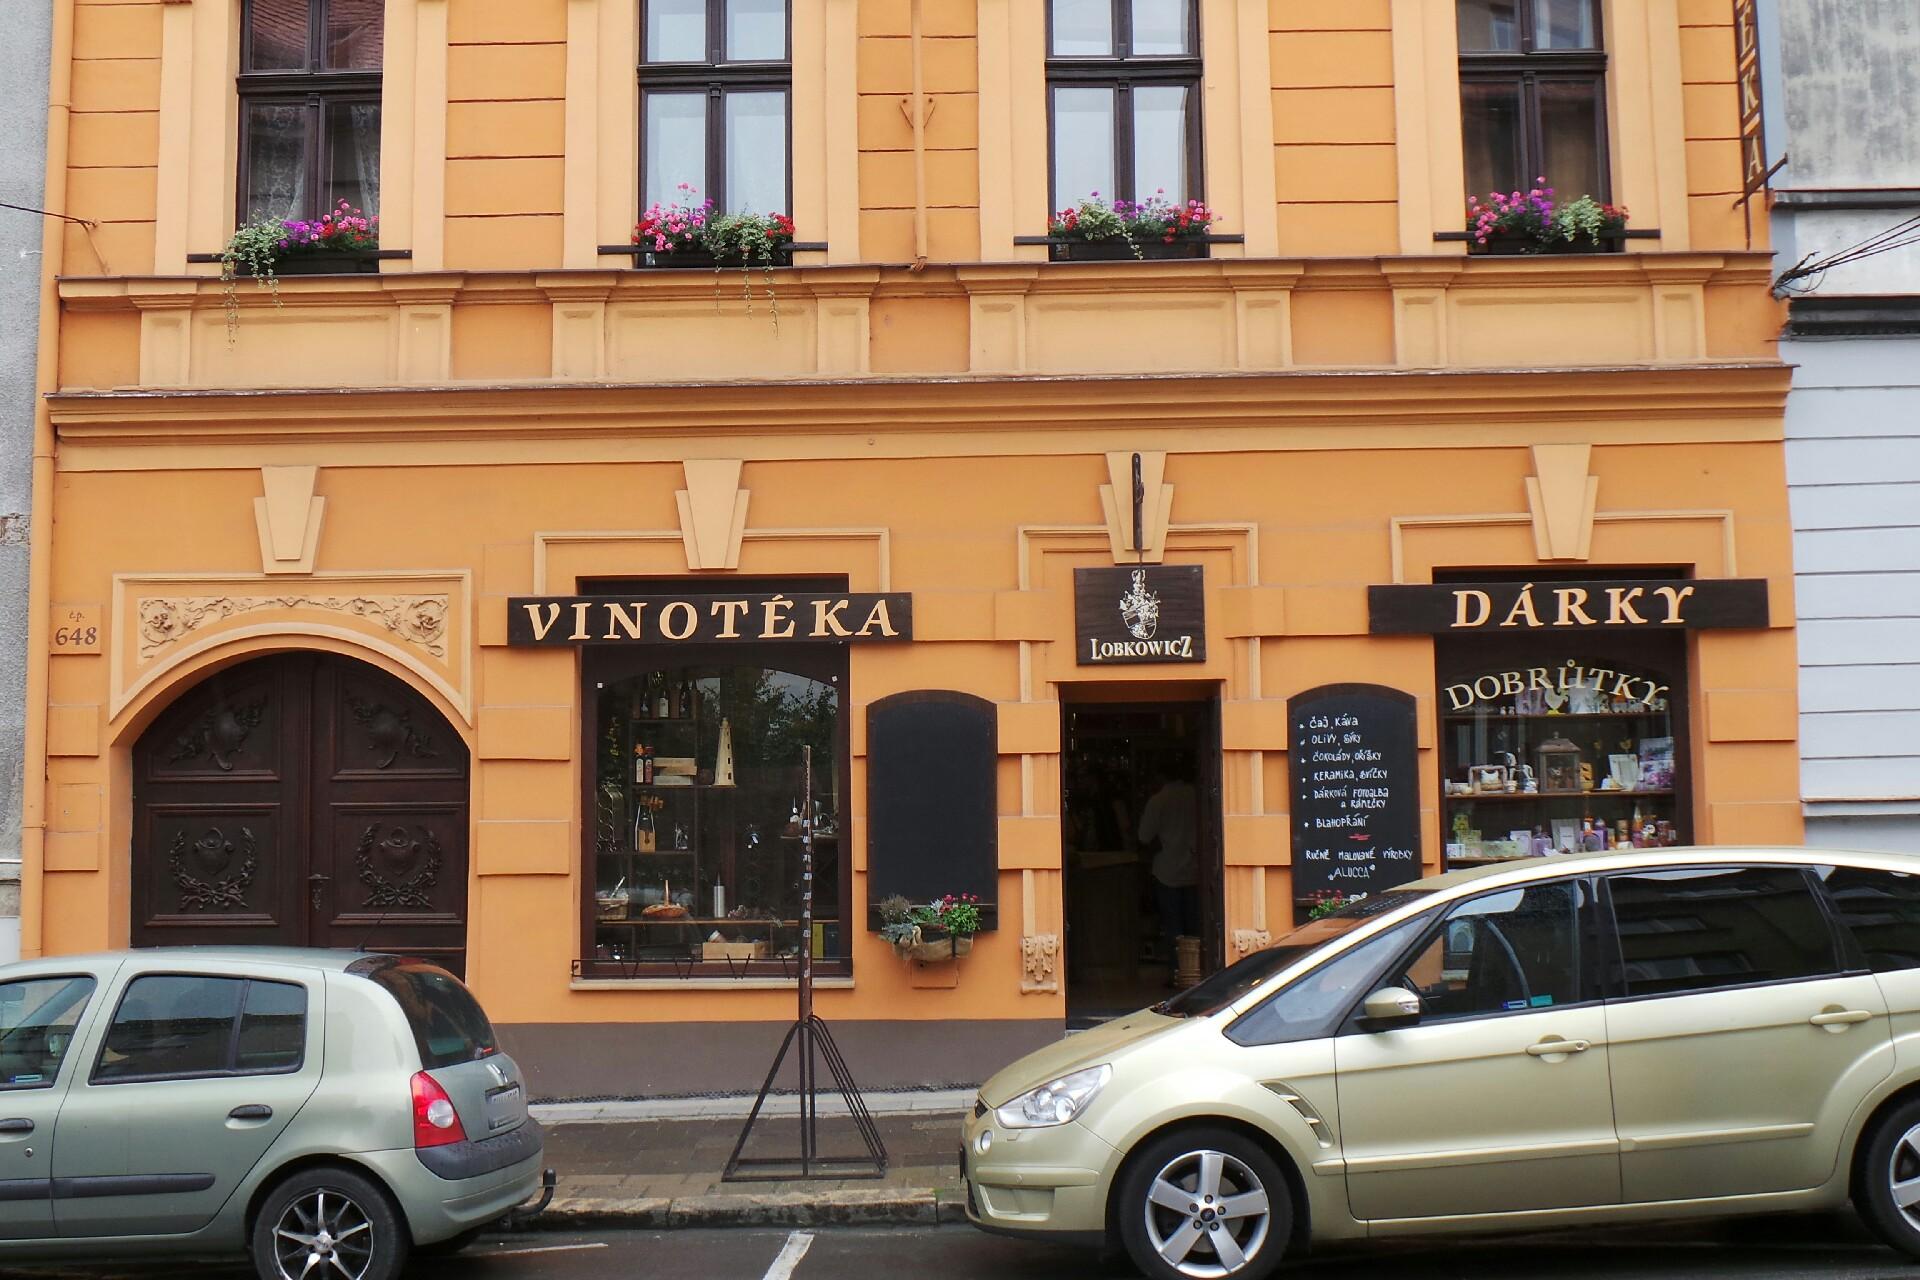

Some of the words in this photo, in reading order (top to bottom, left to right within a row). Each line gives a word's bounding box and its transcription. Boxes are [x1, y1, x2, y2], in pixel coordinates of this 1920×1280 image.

[522, 594, 899, 641] VINOTÉKA
[1450, 583, 1695, 628] DÁRKY
[55, 626, 97, 646] 648
